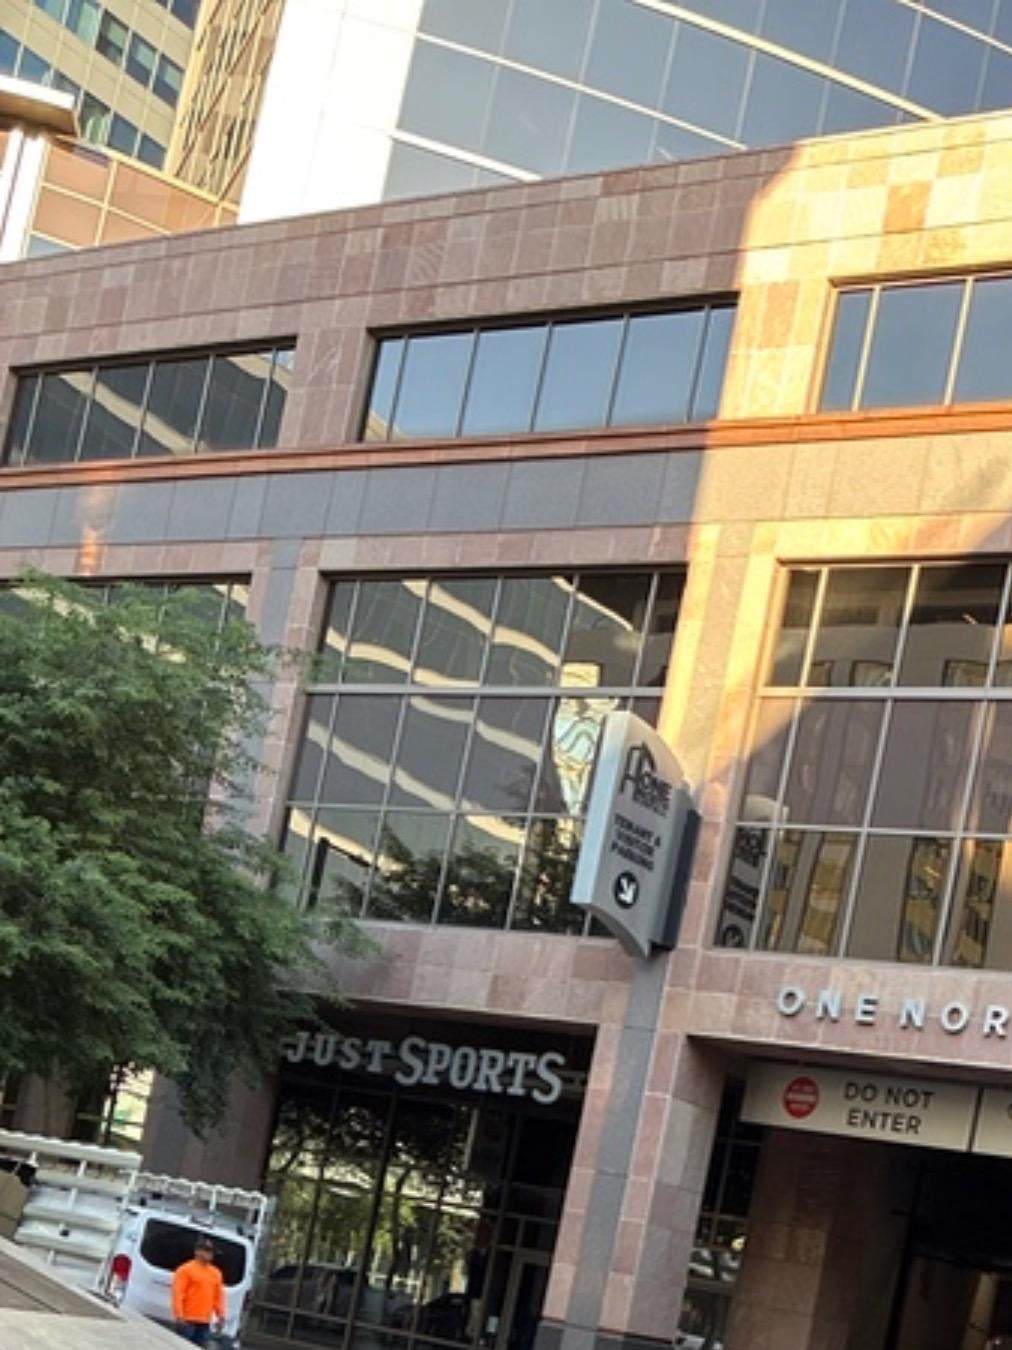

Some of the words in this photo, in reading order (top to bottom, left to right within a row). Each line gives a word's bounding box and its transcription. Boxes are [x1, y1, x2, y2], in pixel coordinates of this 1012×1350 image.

[775, 985, 877, 1027] ONE
[287, 1031, 391, 1073] JUST
[395, 1036, 566, 1104] SPORTS
[844, 1081, 878, 1102] DO
[885, 1086, 935, 1109] NOT
[847, 1109, 922, 1134] ENTER
